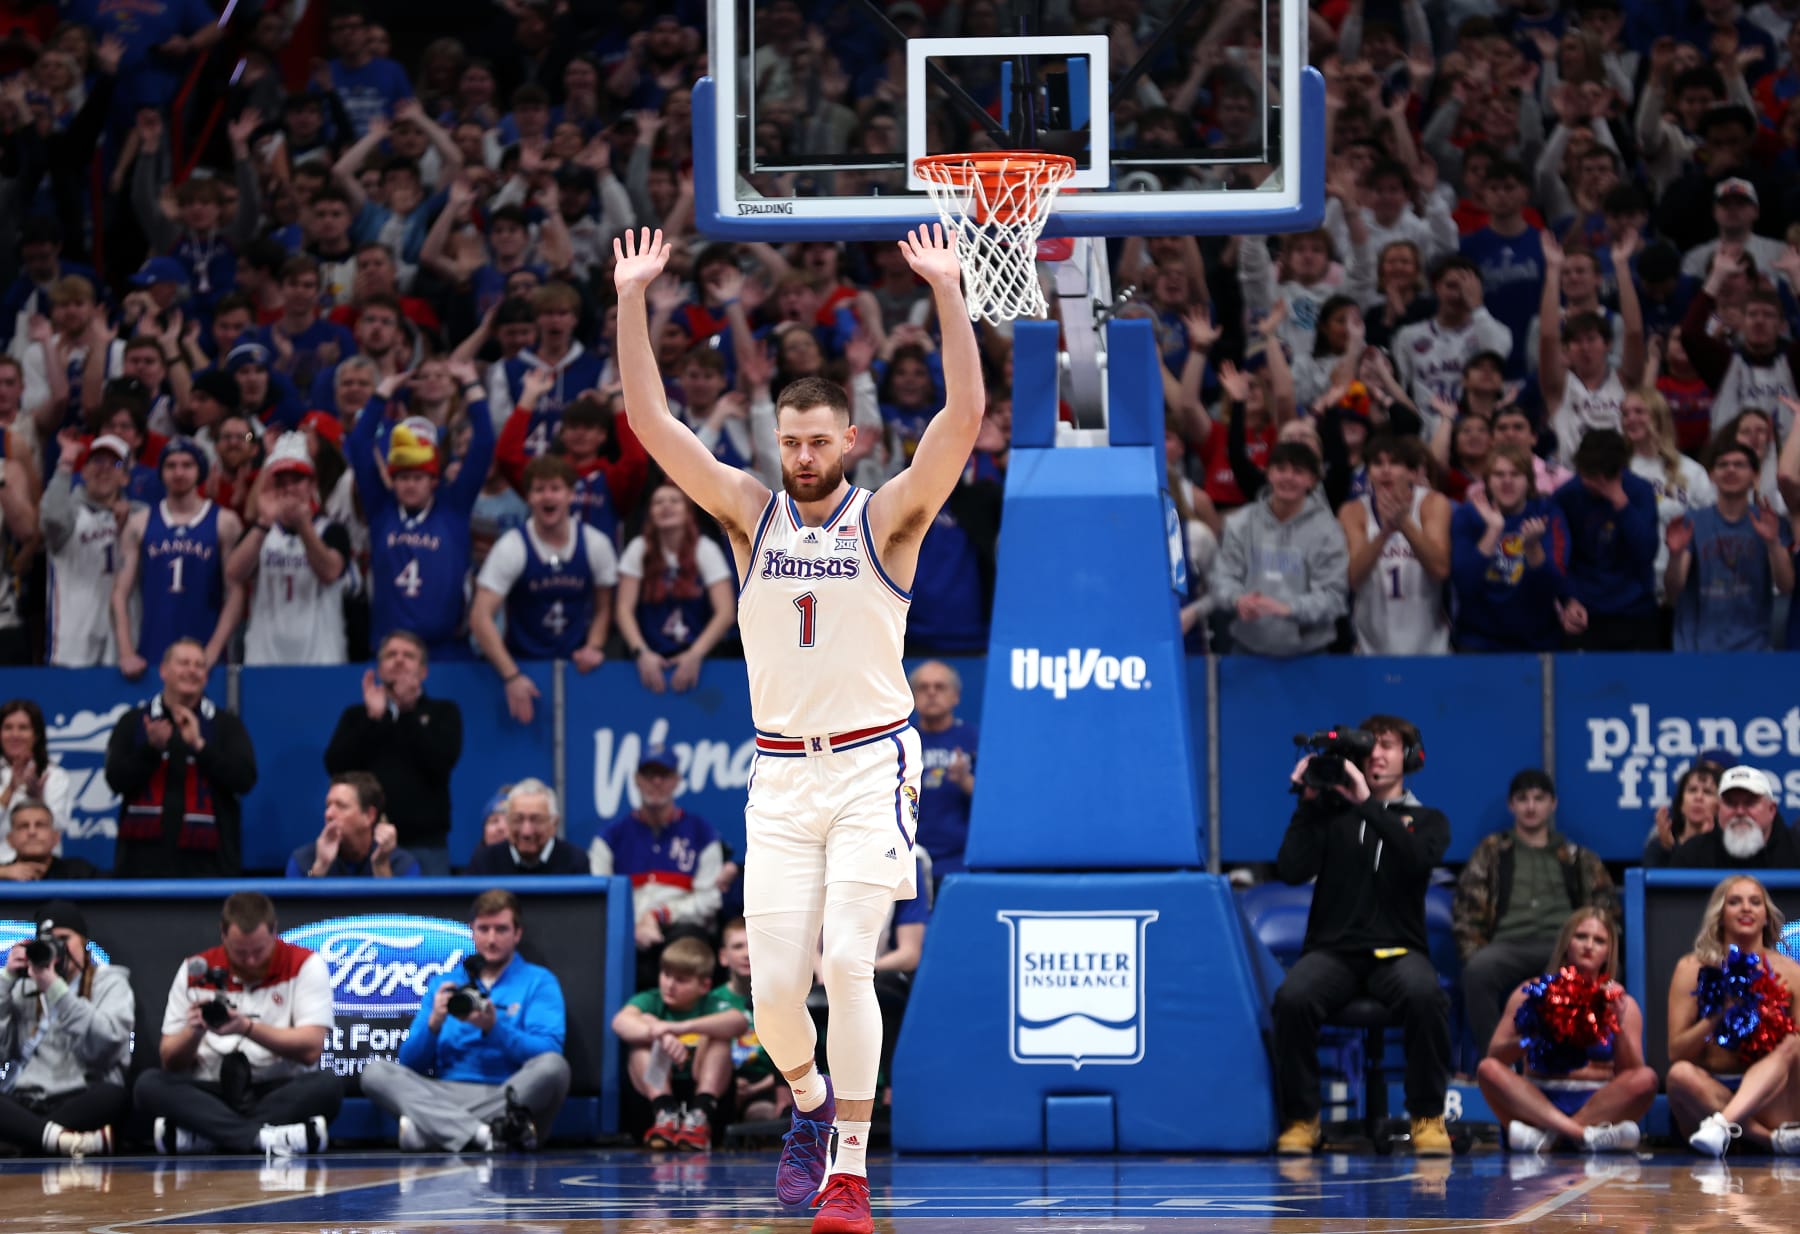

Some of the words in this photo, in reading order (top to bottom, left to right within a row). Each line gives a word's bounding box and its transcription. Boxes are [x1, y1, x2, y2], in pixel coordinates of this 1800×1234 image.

[737, 202, 793, 216] SPALDING
[167, 556, 186, 594] 1
[393, 558, 423, 598] 4
[761, 548, 860, 579] Kansas
[1386, 566, 1404, 600] 1
[541, 600, 569, 635] 4
[661, 608, 691, 643] 4
[792, 591, 817, 647] 1
[810, 737, 823, 752] K
[1024, 952, 1130, 971] SHELTER
[1024, 974, 1130, 988] INSURANCE
